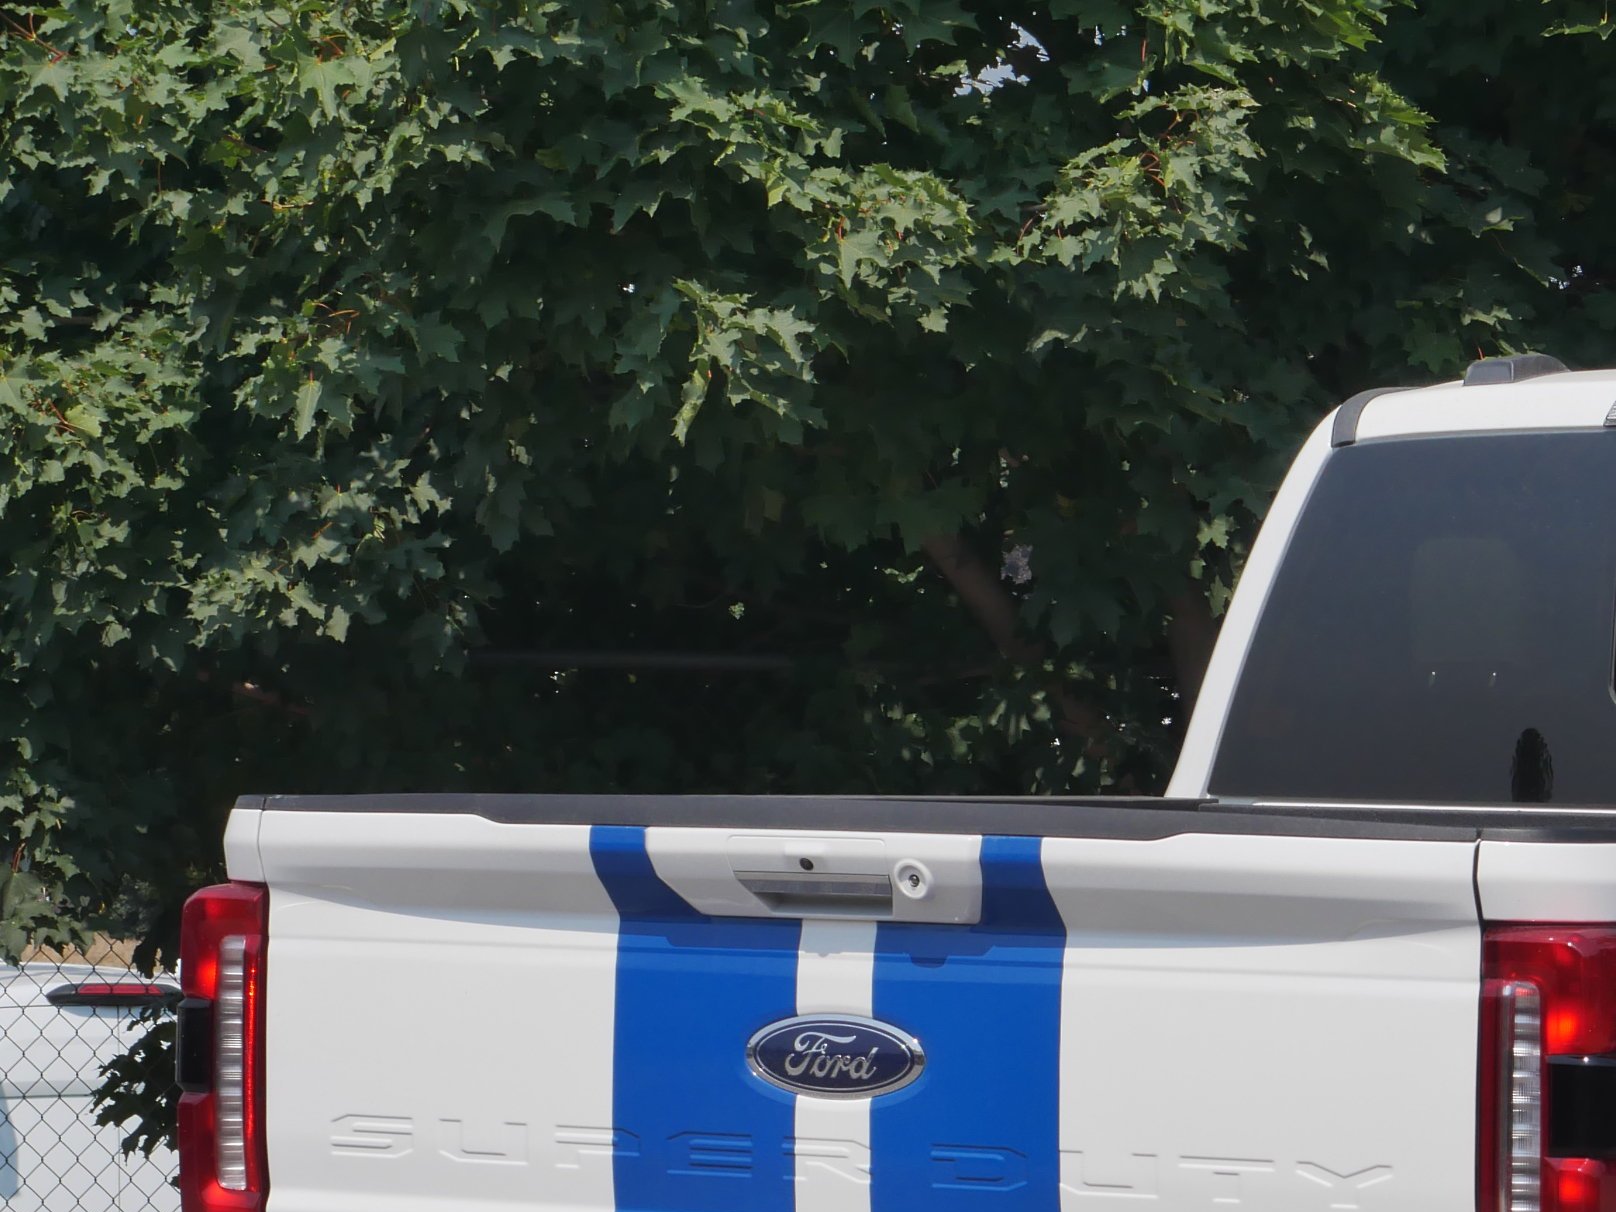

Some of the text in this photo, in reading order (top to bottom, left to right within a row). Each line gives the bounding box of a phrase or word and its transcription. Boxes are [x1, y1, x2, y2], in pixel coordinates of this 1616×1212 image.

[784, 1031, 879, 1080] Ford
[330, 1113, 1393, 1209] SUPER DUTY
